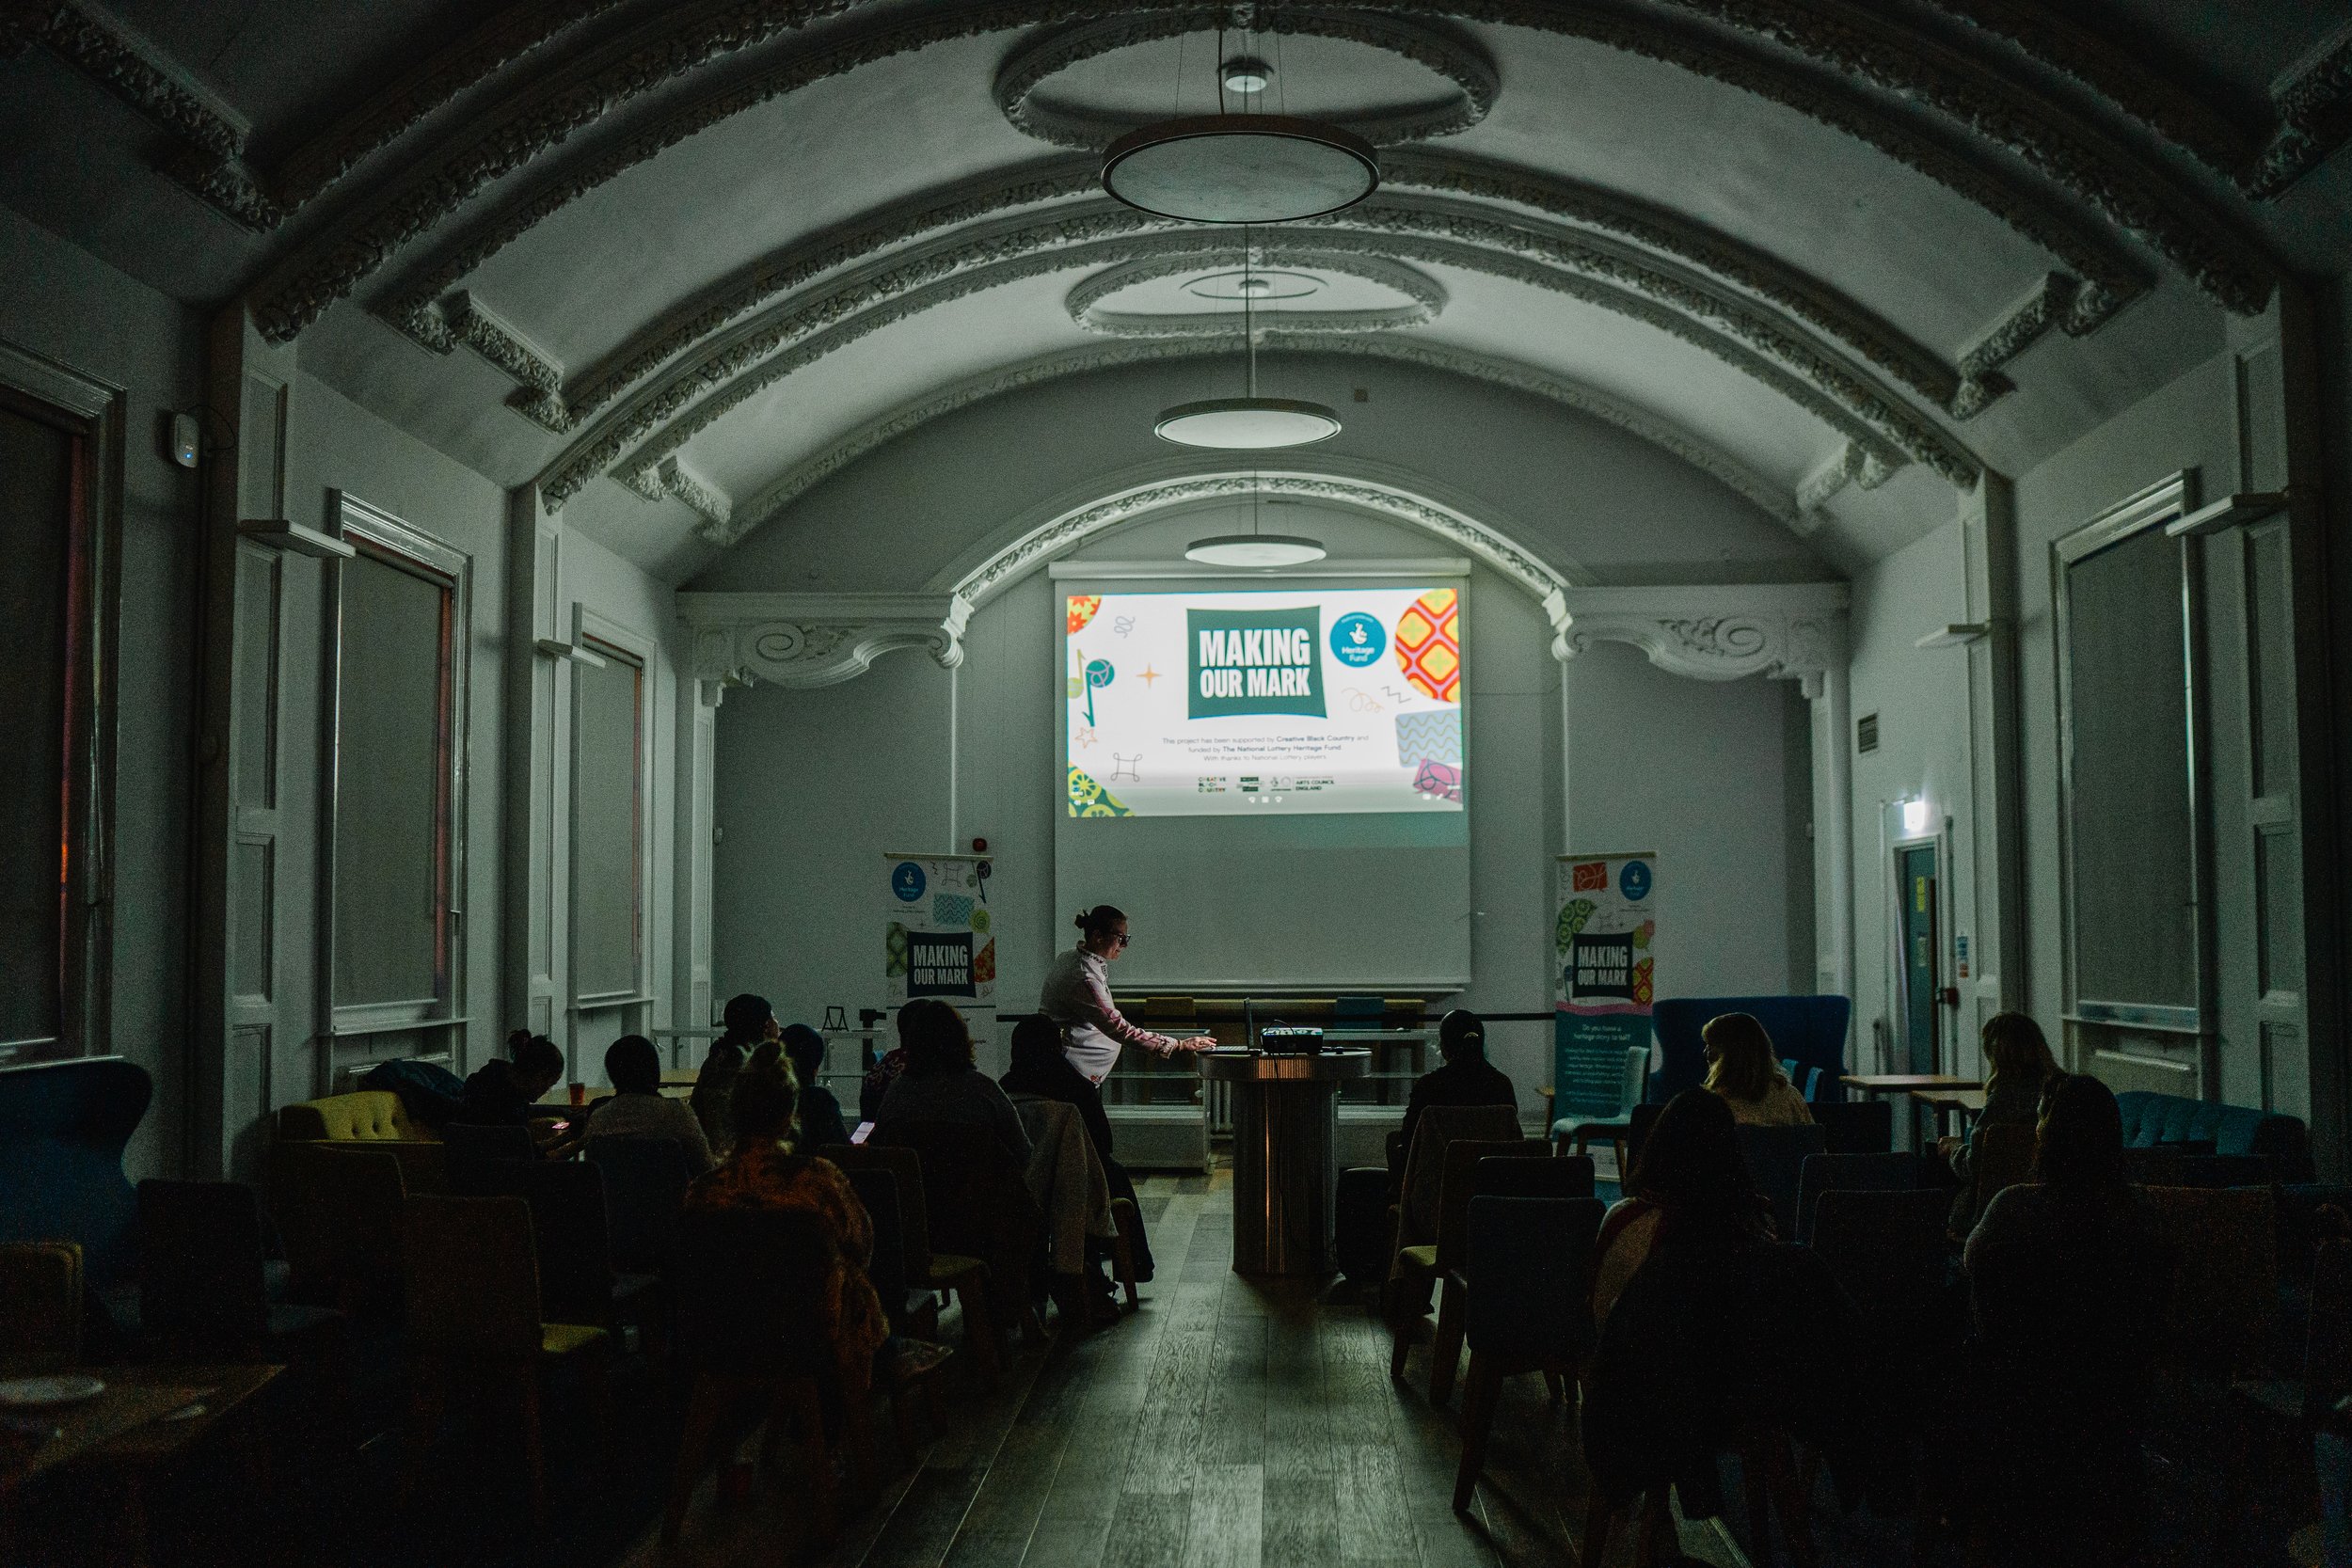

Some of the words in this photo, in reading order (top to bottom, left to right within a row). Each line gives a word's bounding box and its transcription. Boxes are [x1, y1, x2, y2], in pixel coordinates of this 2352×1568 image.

[1200, 628, 1311, 667] MAKING
[1342, 646, 1375, 656] Heritage
[1349, 654, 1369, 662] Fund
[1200, 669, 1244, 698] OUR
[1247, 667, 1311, 697] MARK
[914, 944, 969, 967] MAKING
[1577, 945, 1629, 968] MAKING
[914, 968, 936, 985] OUR
[937, 968, 969, 985] MARK
[1578, 968, 1597, 986] OUR
[1597, 968, 1629, 986] MARK
